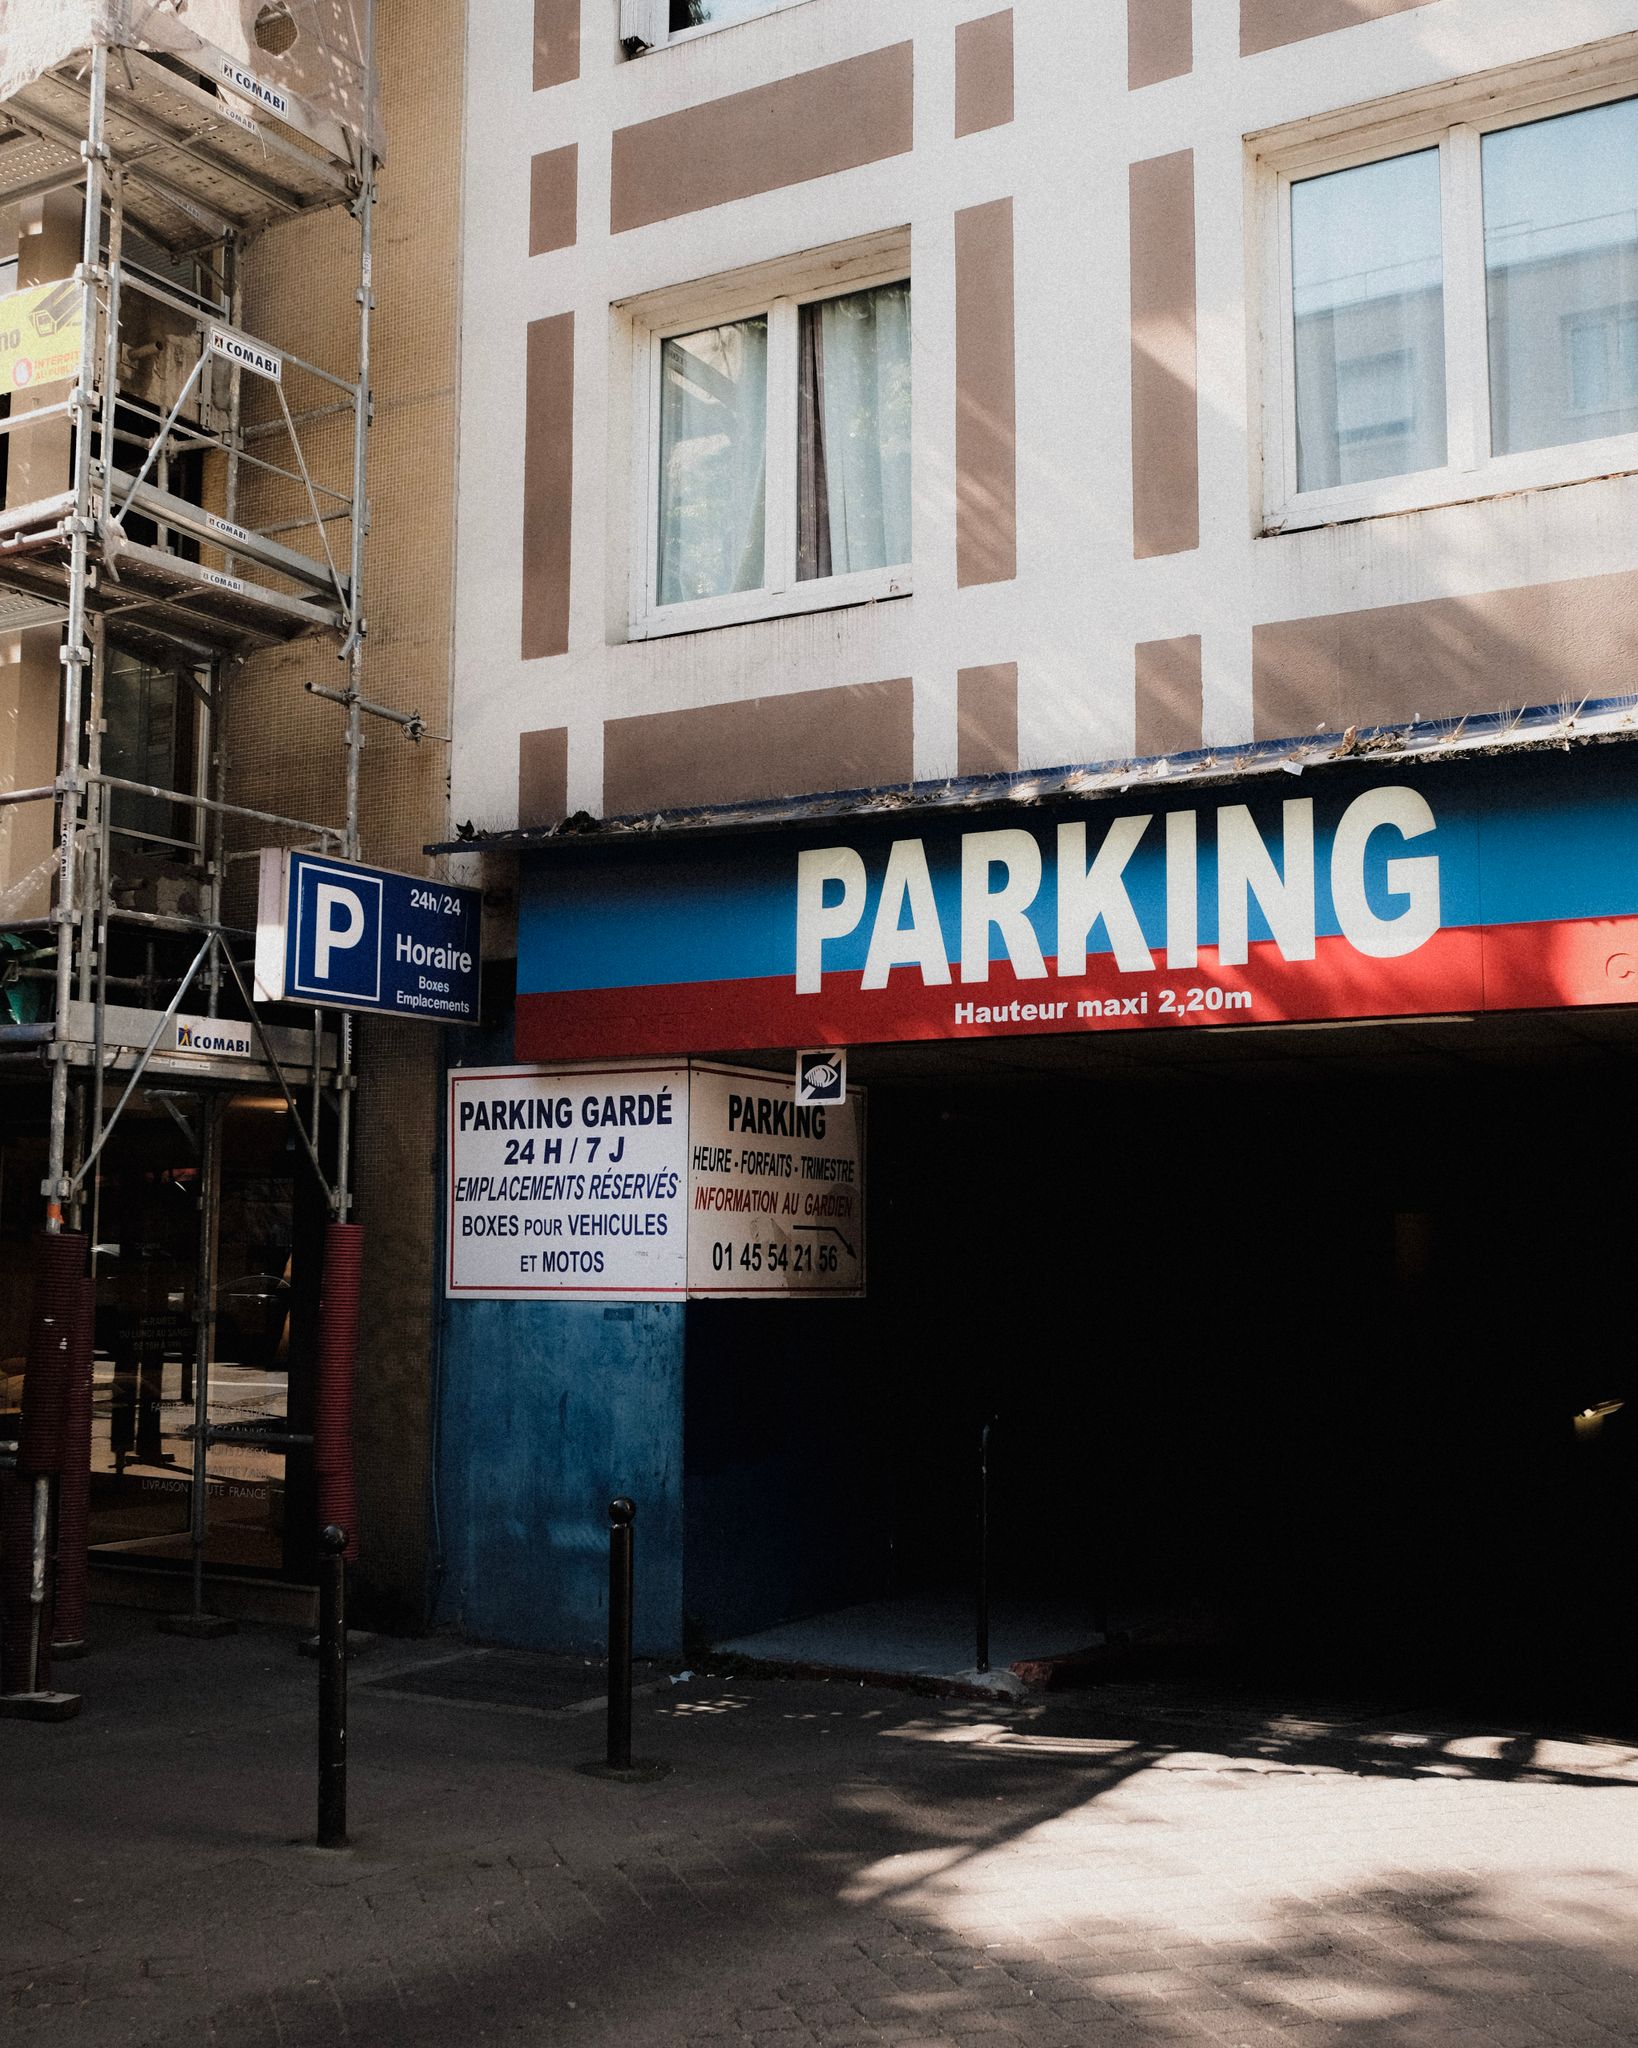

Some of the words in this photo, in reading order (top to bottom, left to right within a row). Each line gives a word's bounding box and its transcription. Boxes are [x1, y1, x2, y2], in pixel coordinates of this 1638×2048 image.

[236, 73, 285, 112] COMABI
[227, 342, 277, 374] COMABI
[216, 521, 246, 540] COMABI
[210, 574, 241, 590] COMABI
[411, 889, 461, 916] 24h/24
[796, 785, 1441, 995] PARKING
[314, 883, 365, 979] P
[396, 933, 472, 973] Horaire
[419, 976, 449, 992] Boxes
[397, 991, 470, 1013] Emplacements
[954, 1000, 1068, 1024] Hauteur
[1077, 992, 1148, 1018] maxi
[1158, 987, 1252, 1017] 2,20m
[194, 1036, 249, 1052] COMABI
[460, 1097, 573, 1131] PARKING
[582, 1085, 673, 1128] GARDÉ
[728, 1094, 826, 1140] PARKING
[504, 1139, 535, 1165] 24
[544, 1138, 563, 1164] H
[586, 1137, 601, 1163] 7
[608, 1136, 625, 1163] J
[692, 1146, 732, 1173] HEURE
[740, 1151, 792, 1178] FORFAITS
[801, 1157, 854, 1183] TRIMESTRE
[456, 1175, 585, 1201] EMPLACEMENTS
[588, 1166, 679, 1200] RÉSERVÉS
[695, 1186, 779, 1214] INFORMATION
[782, 1192, 799, 1215] AU
[804, 1193, 853, 1217] GARDIEN
[462, 1215, 519, 1236] BOXES
[524, 1219, 563, 1236] POUR
[568, 1213, 668, 1236] VEHICULES
[520, 1255, 537, 1272] ET
[542, 1251, 604, 1273] MOTOS
[712, 1242, 733, 1271] 01
[740, 1243, 762, 1271] 45
[768, 1244, 789, 1271] 54
[793, 1244, 812, 1271] 21
[819, 1245, 838, 1272] 56
[142, 1480, 189, 1493] LIVRAISON
[229, 1486, 267, 1500] FRANCE
